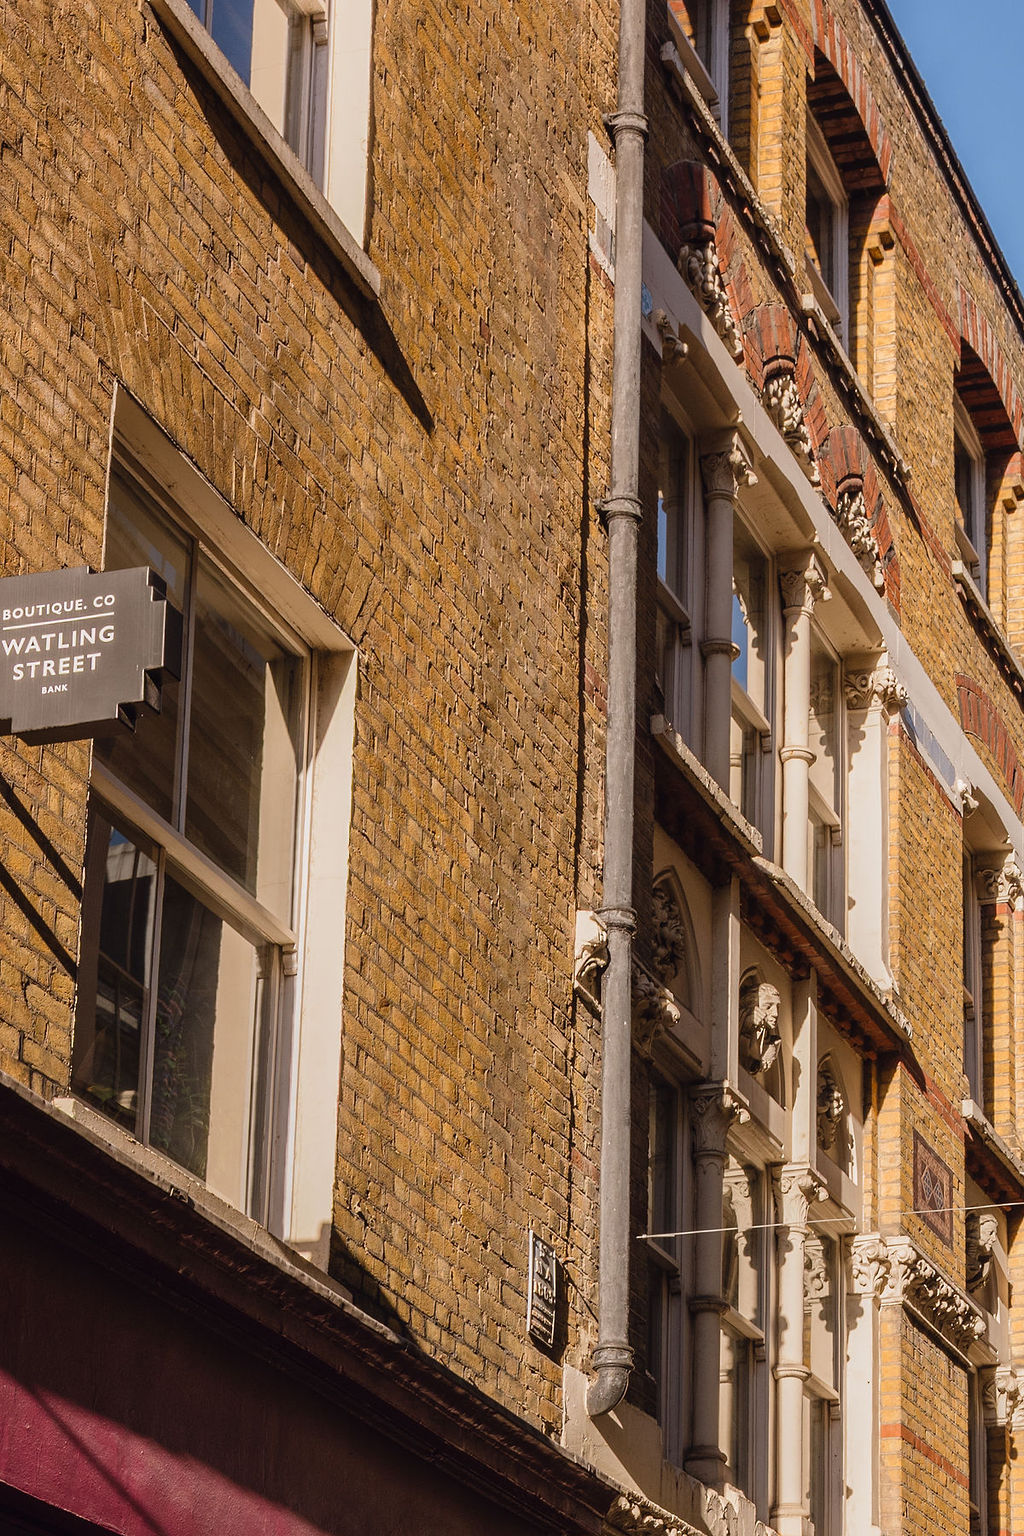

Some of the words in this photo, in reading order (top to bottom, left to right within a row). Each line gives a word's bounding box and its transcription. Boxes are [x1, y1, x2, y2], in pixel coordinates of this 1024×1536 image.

[2, 599, 88, 621] BOUTIQUE.
[93, 594, 115, 608] CO
[1, 625, 115, 656] WATLING
[13, 652, 102, 681] STREET
[41, 684, 68, 695] BANK
